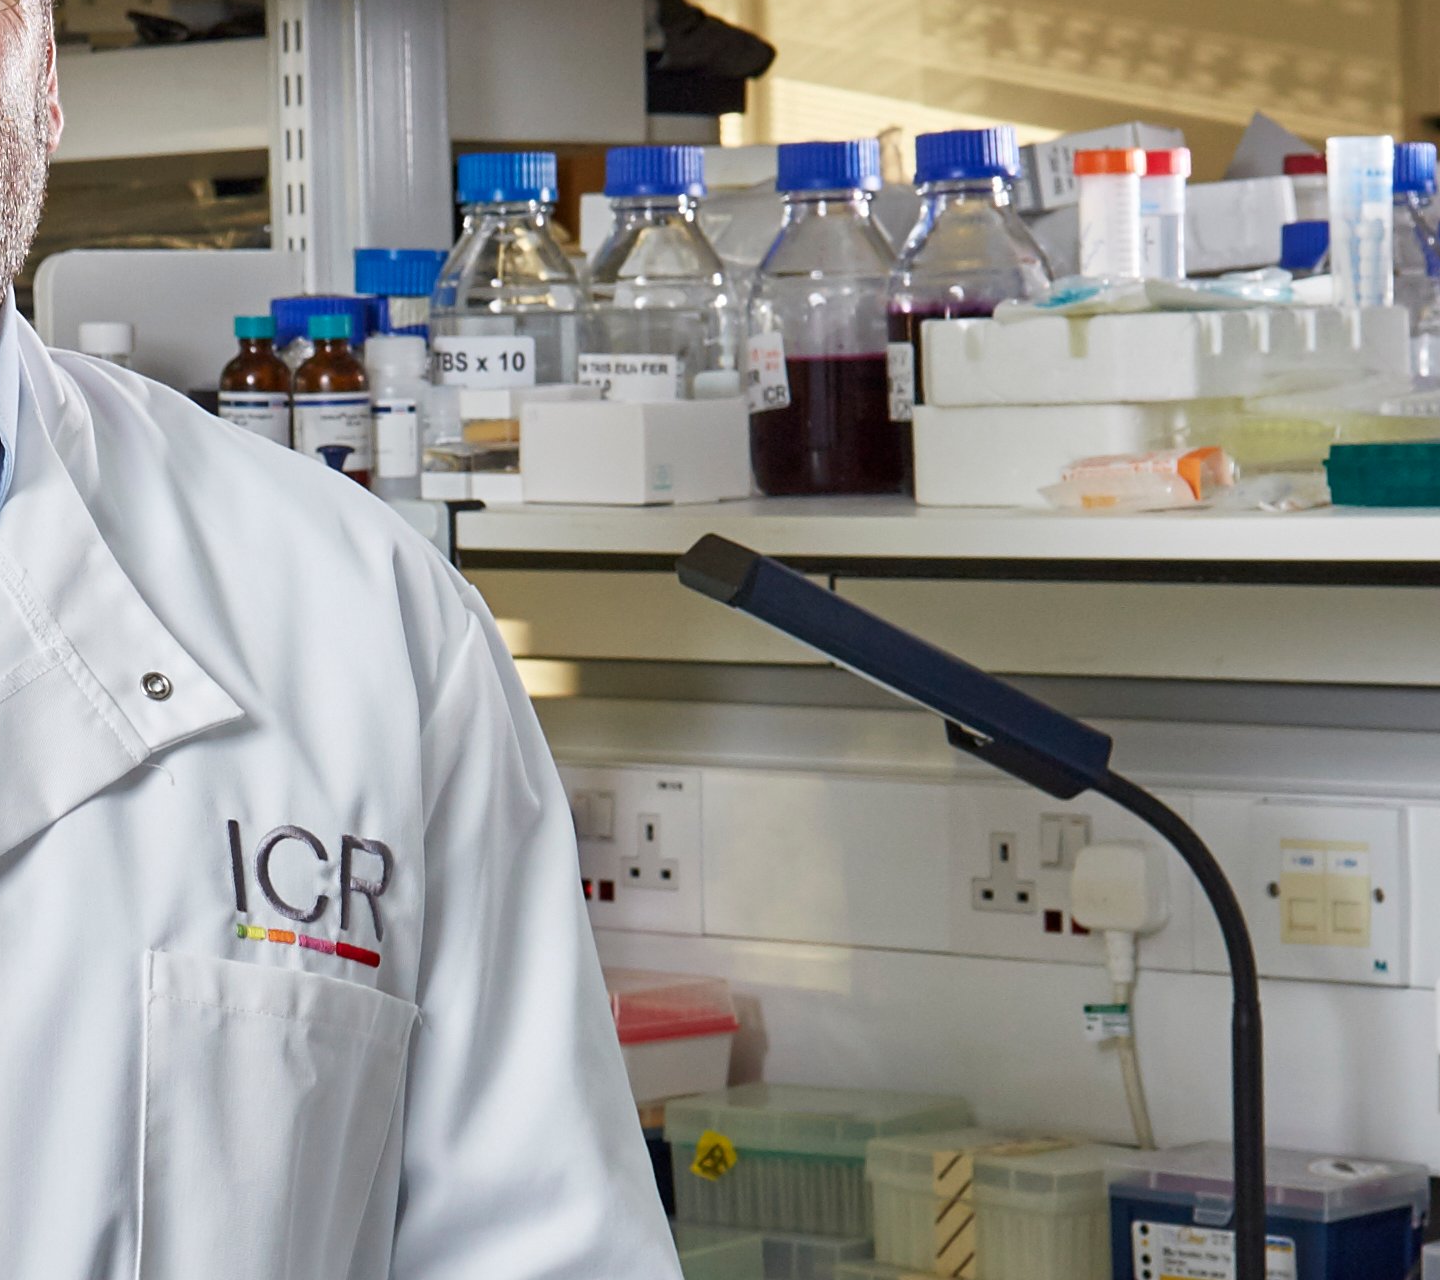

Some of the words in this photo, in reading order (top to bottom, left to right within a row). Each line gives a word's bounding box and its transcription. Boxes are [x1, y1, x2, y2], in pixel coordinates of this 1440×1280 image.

[476, 357, 488, 372] x
[499, 351, 526, 372] 10
[227, 818, 393, 943] ICR
